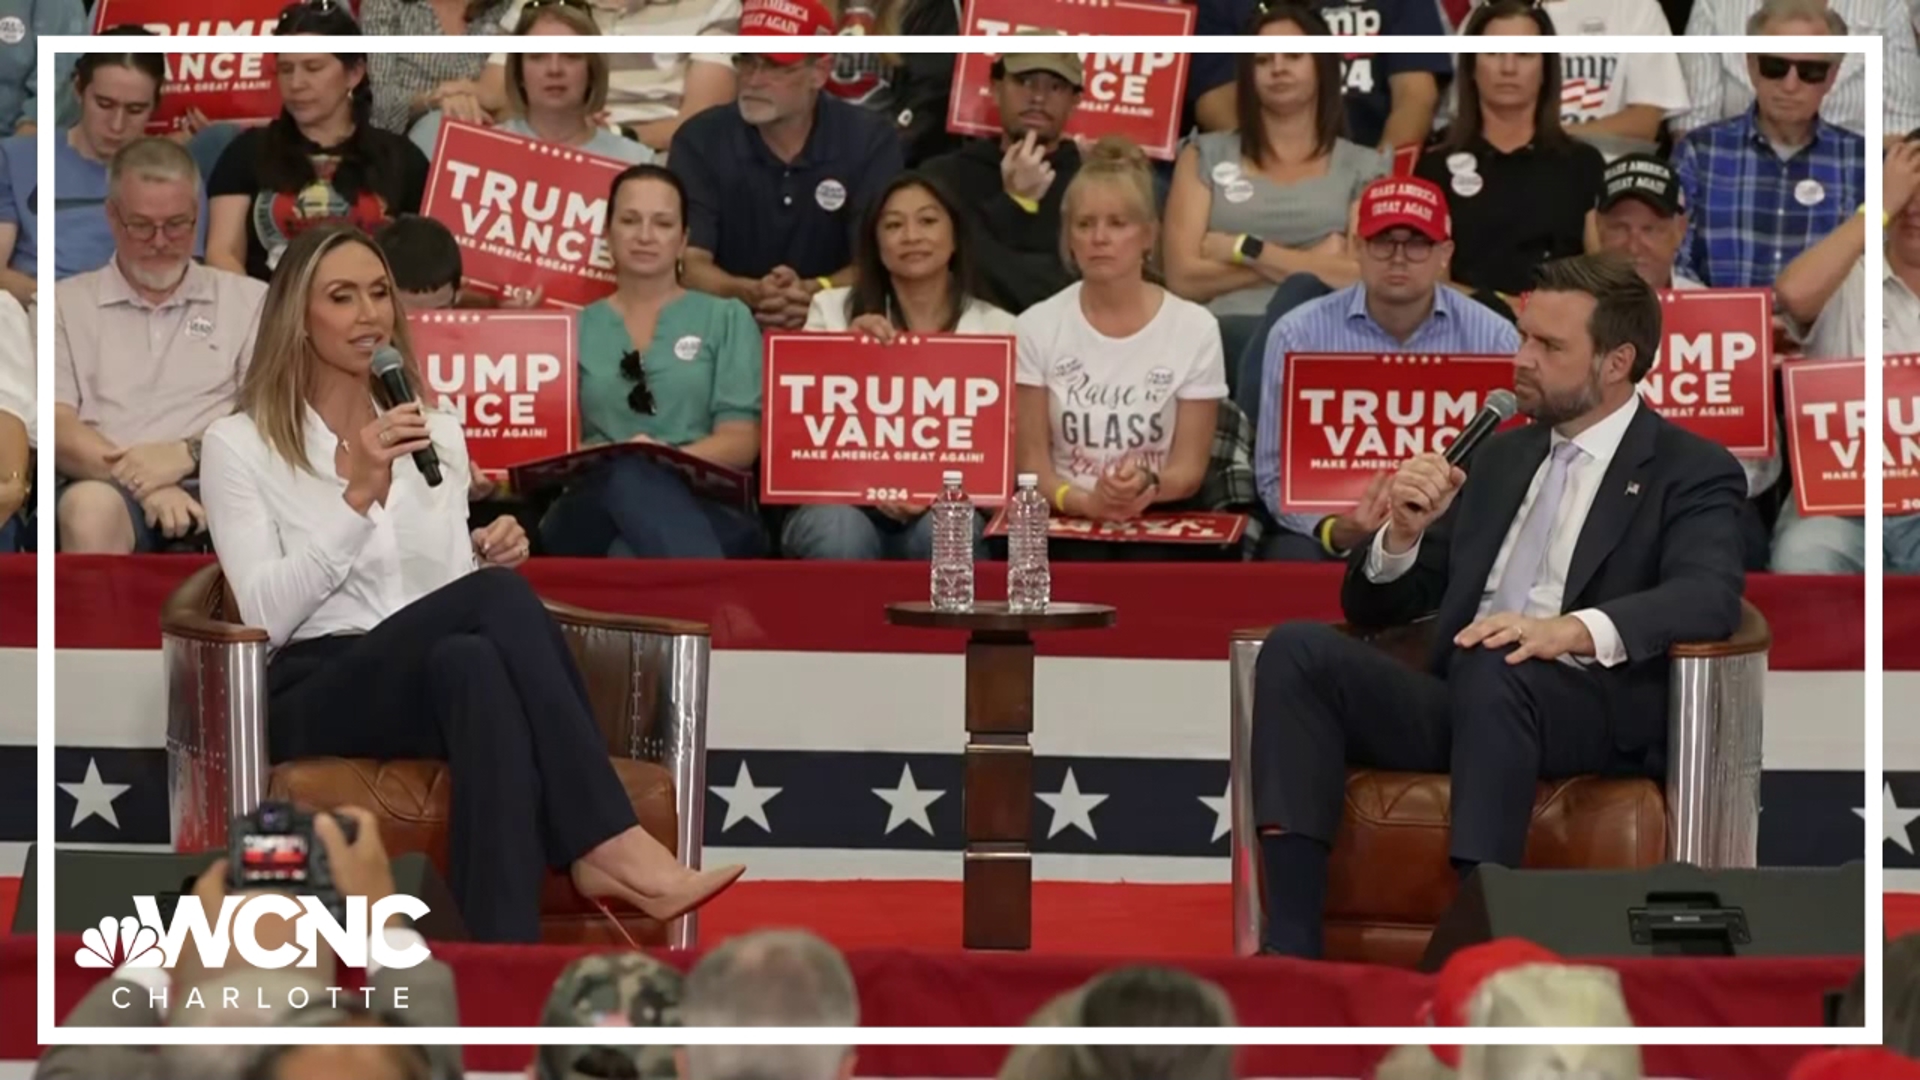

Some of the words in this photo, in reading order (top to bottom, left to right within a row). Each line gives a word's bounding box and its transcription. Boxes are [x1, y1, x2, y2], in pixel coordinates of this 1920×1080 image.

[447, 160, 608, 236] TRUM
[427, 353, 561, 394] UMP
[779, 374, 1001, 418] TRUMP
[1299, 388, 1477, 426] TRUM
[465, 427, 499, 439] REAT
[803, 414, 974, 450] VANCE
[1061, 410, 1165, 450] GLASS
[1323, 425, 1461, 457] VANC
[791, 449, 828, 461] MAKE
[832, 450, 890, 462] AMERICA
[894, 451, 935, 463] GREAT
[938, 452, 985, 464] AGAIN!
[1310, 458, 1347, 470] MAKE
[1350, 458, 1400, 470] AMERIC
[1821, 470, 1858, 481] MAKE
[866, 487, 909, 501] 2024
